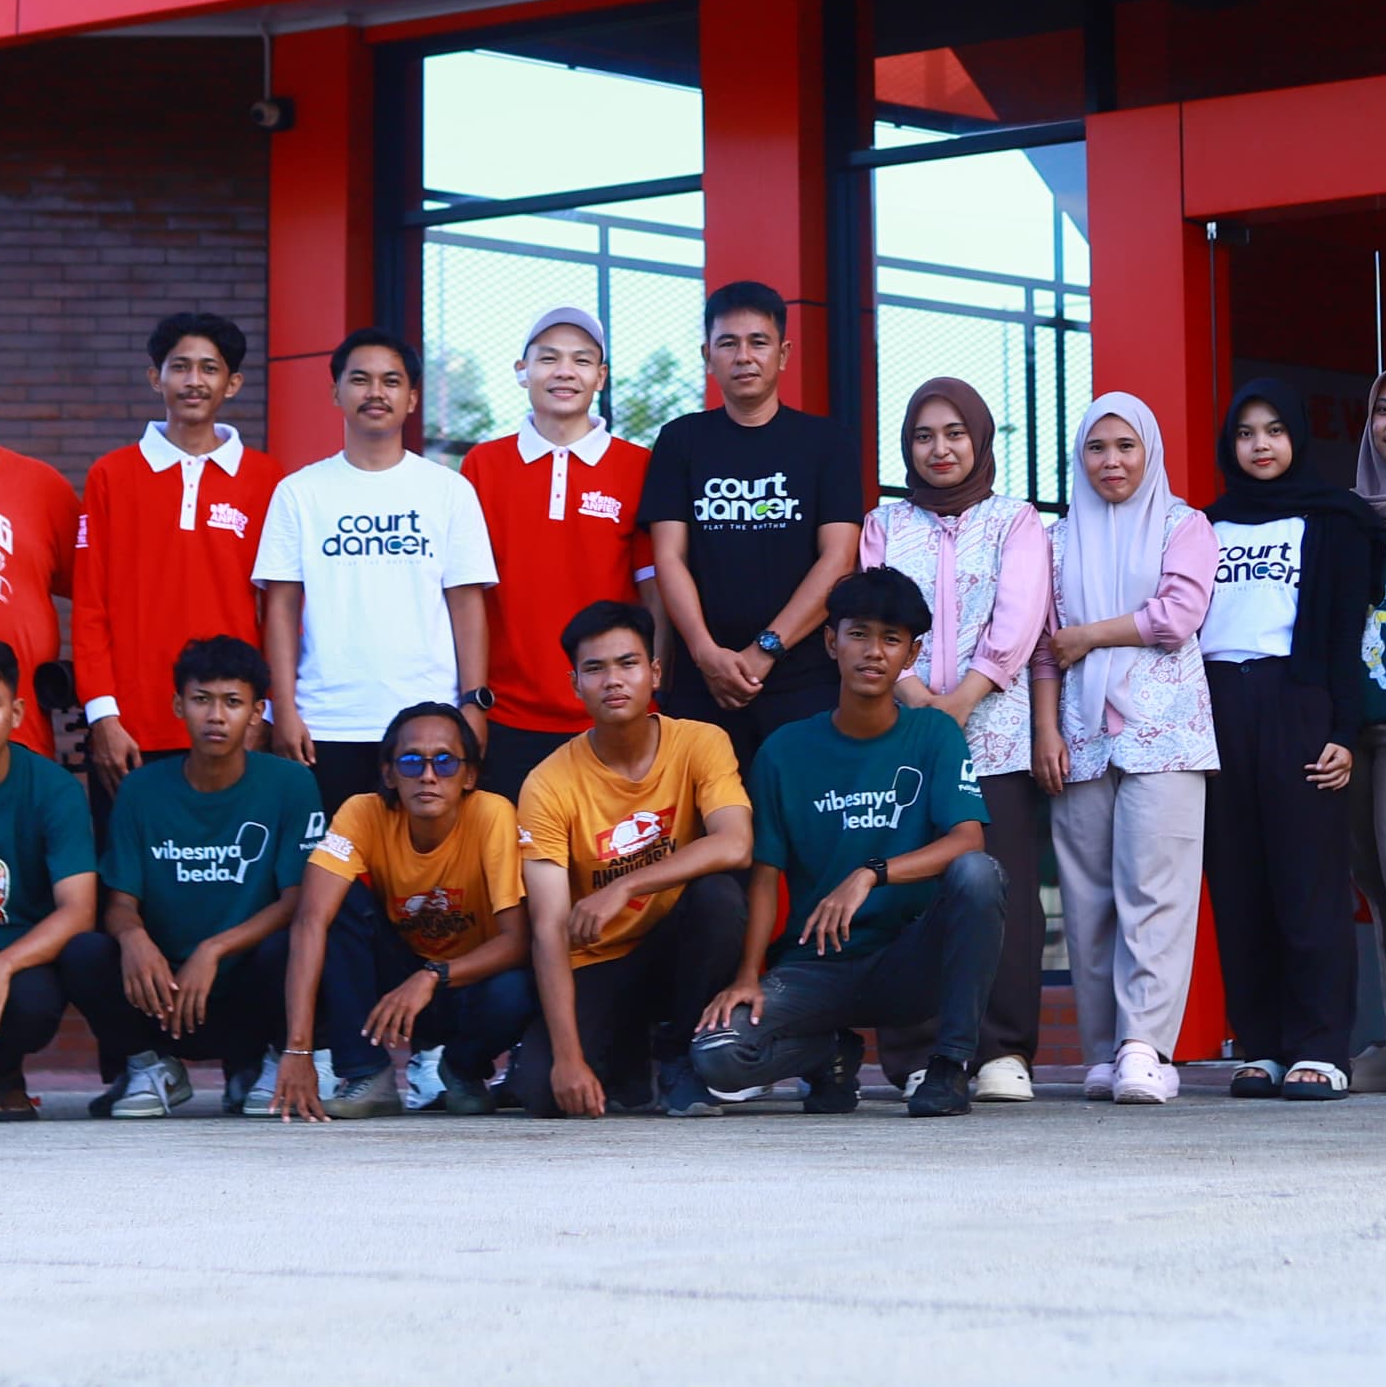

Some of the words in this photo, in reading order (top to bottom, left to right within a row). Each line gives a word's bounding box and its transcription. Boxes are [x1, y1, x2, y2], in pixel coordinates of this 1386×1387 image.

[704, 472, 788, 500] court
[337, 509, 421, 534] court
[693, 497, 803, 522] dancer.
[322, 534, 434, 558] dancer.
[1213, 561, 1302, 589] ancer.
[813, 789, 897, 813] vibesnya
[150, 839, 242, 864] vibesnya
[176, 861, 236, 883] beda.
